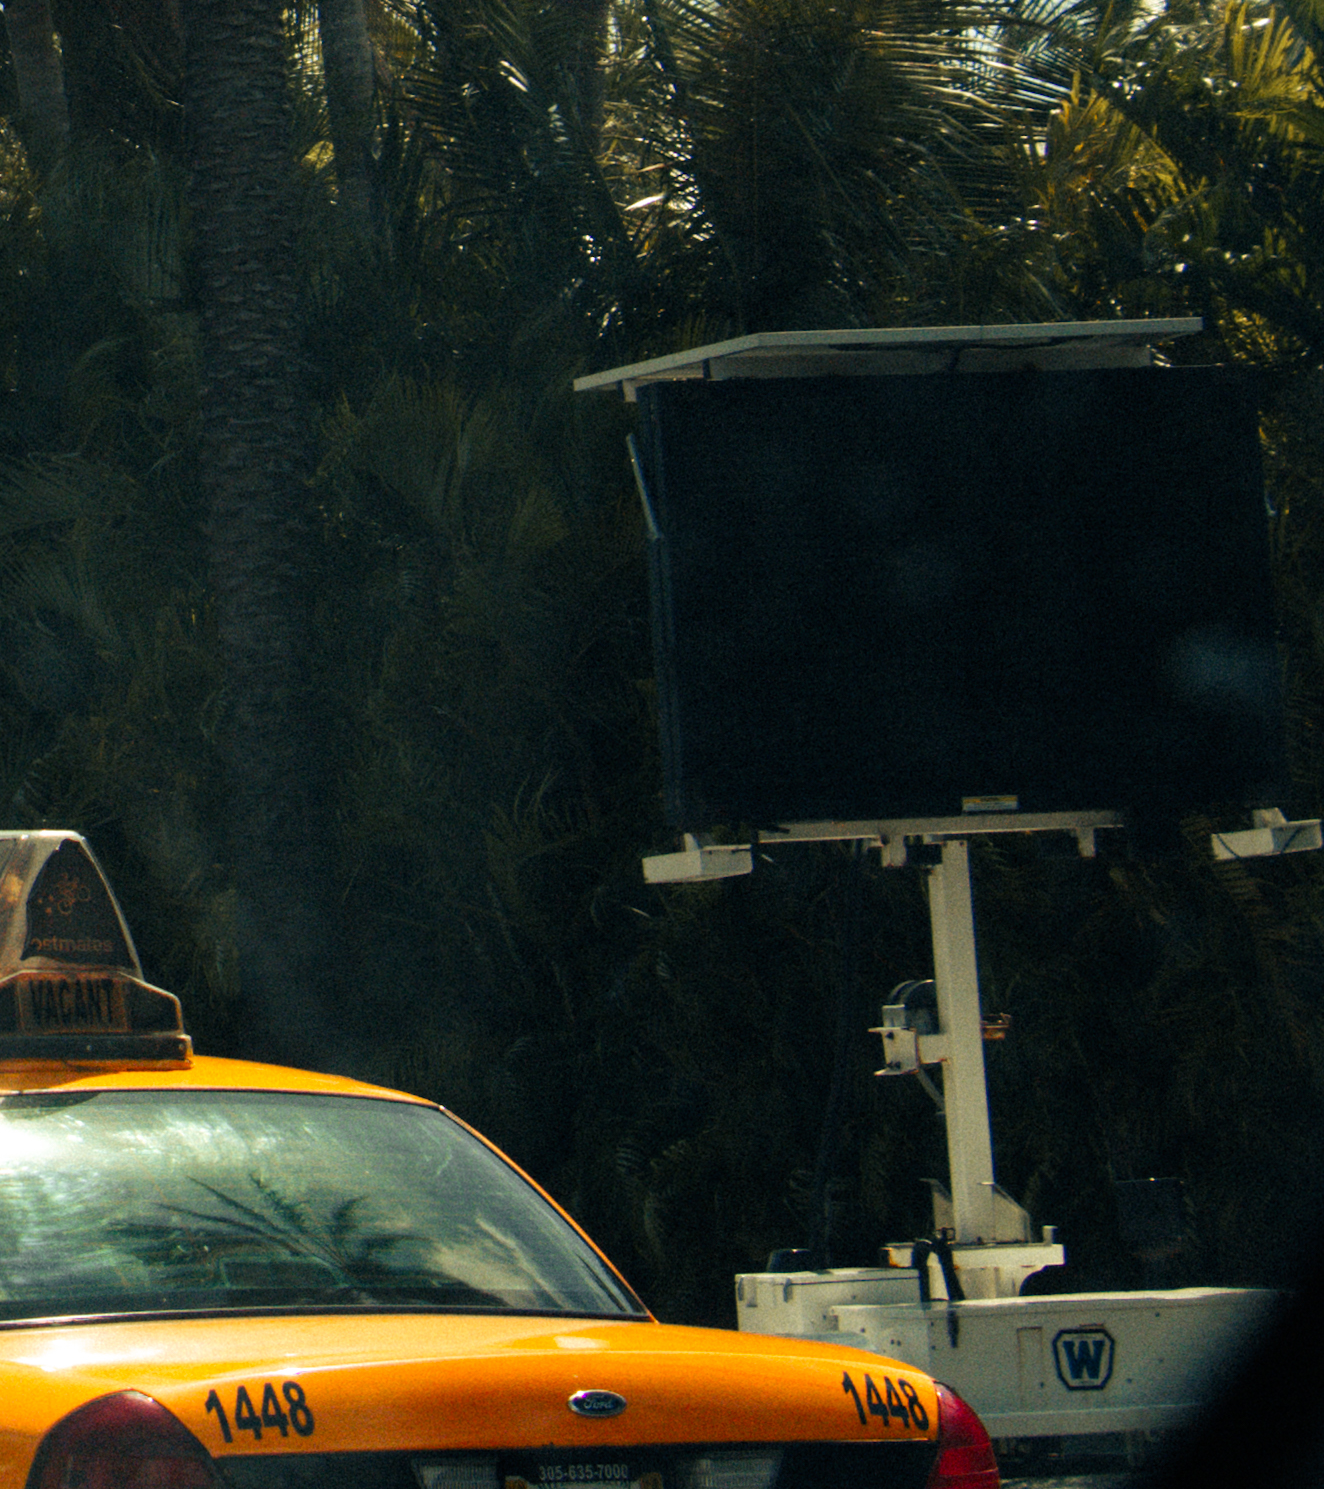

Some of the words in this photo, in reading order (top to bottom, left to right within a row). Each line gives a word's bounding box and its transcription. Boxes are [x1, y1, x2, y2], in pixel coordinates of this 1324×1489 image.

[29, 979, 115, 1026] VACANT
[1063, 1340, 1104, 1379] W
[205, 1381, 315, 1443] 1448
[842, 1371, 930, 1431] 1448
[539, 1464, 629, 1481] 305-635-7000
